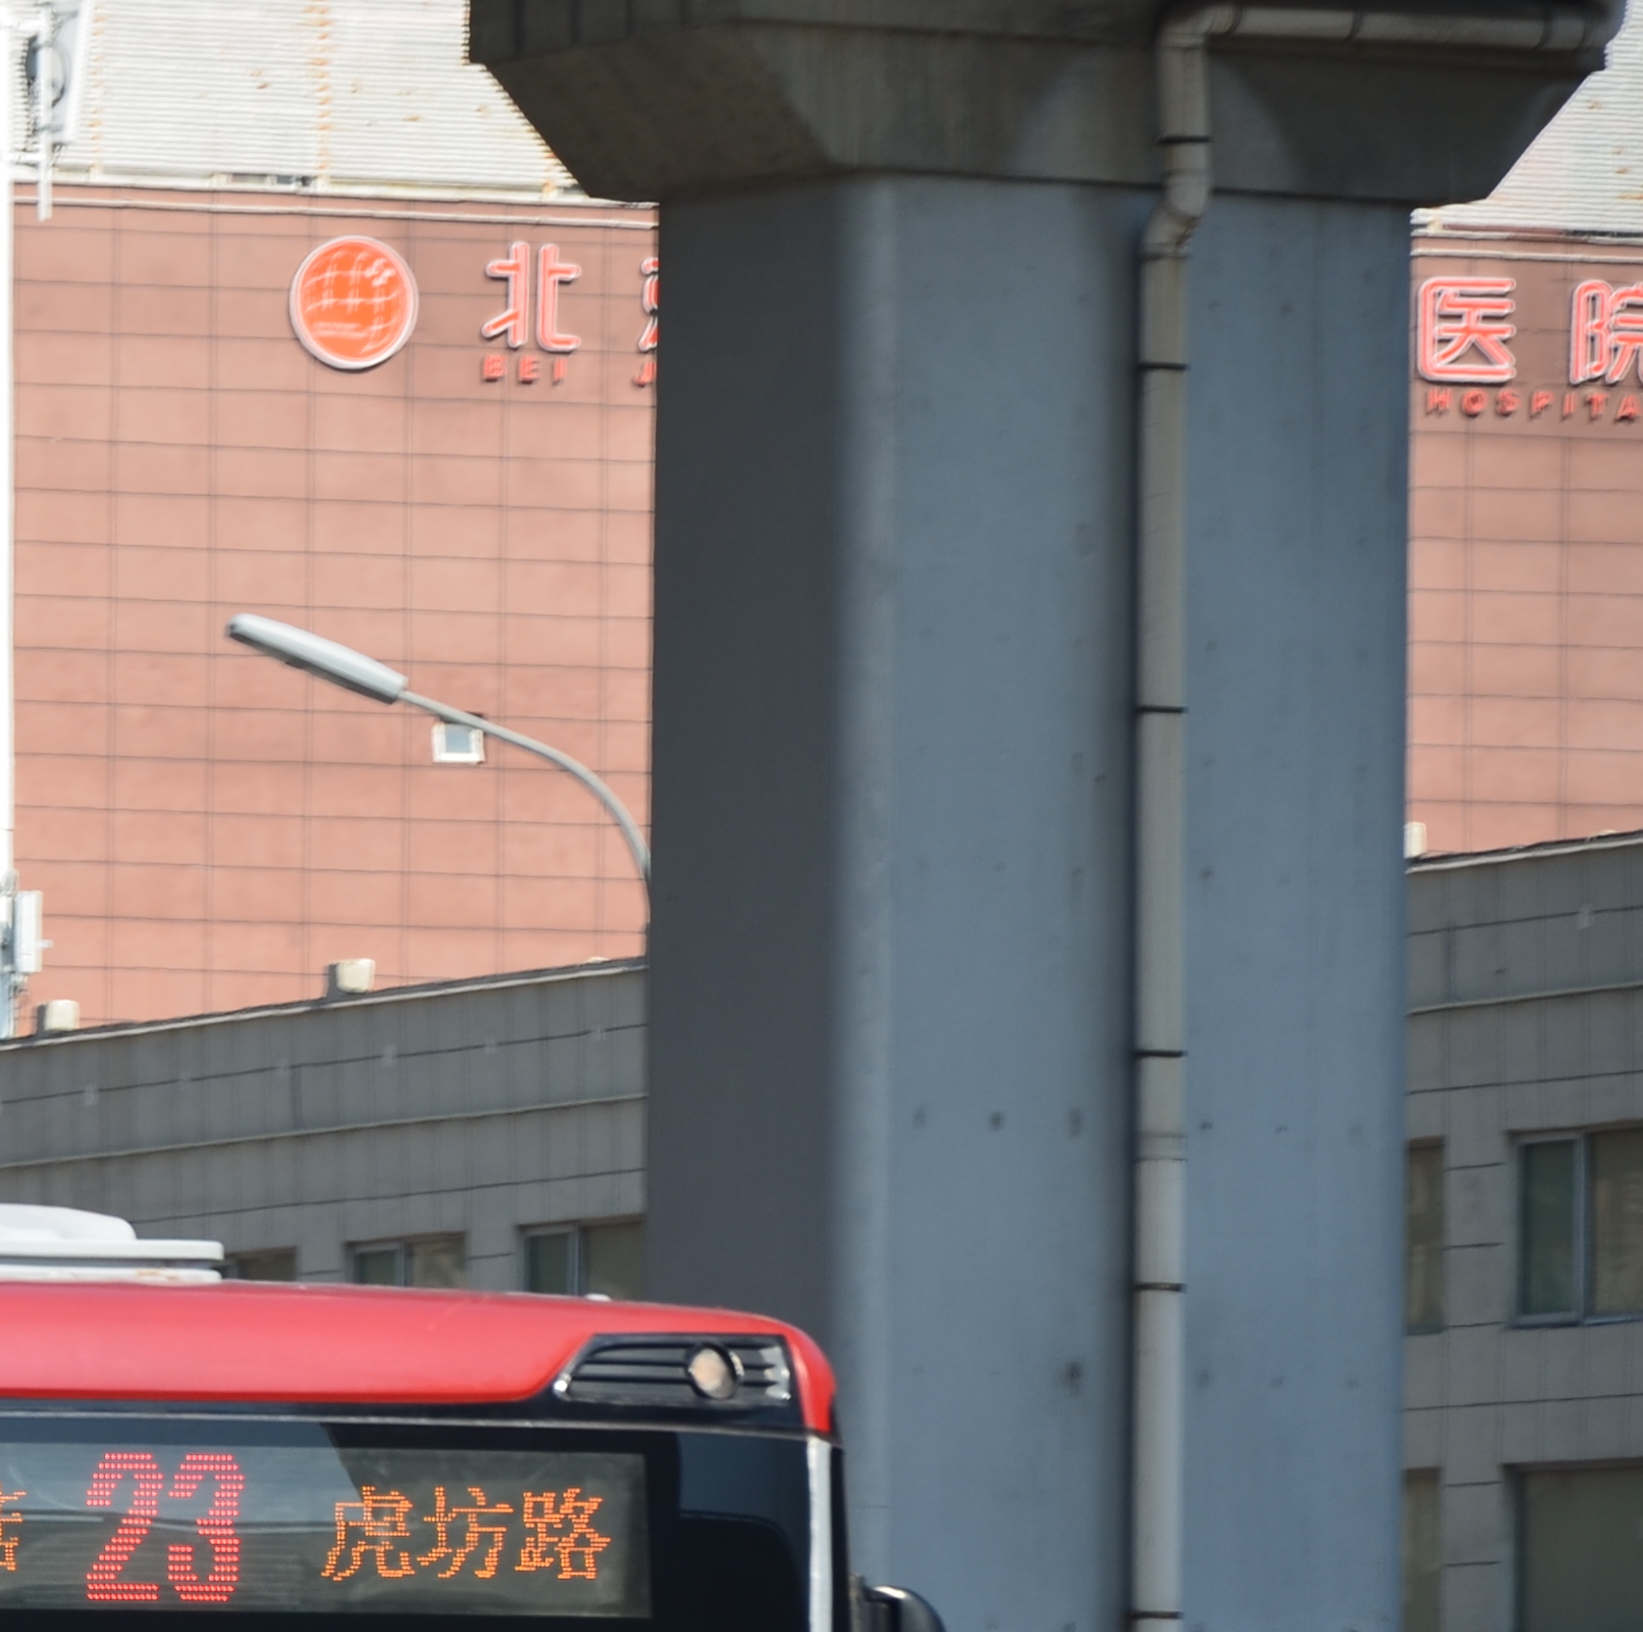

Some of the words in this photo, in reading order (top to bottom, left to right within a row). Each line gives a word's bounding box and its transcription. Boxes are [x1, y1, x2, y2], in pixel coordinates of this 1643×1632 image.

[482, 241, 658, 353] 北
[1418, 276, 1643, 386] 医院
[85, 1451, 245, 1603] 23
[321, 1484, 613, 1581] 虎坊路
